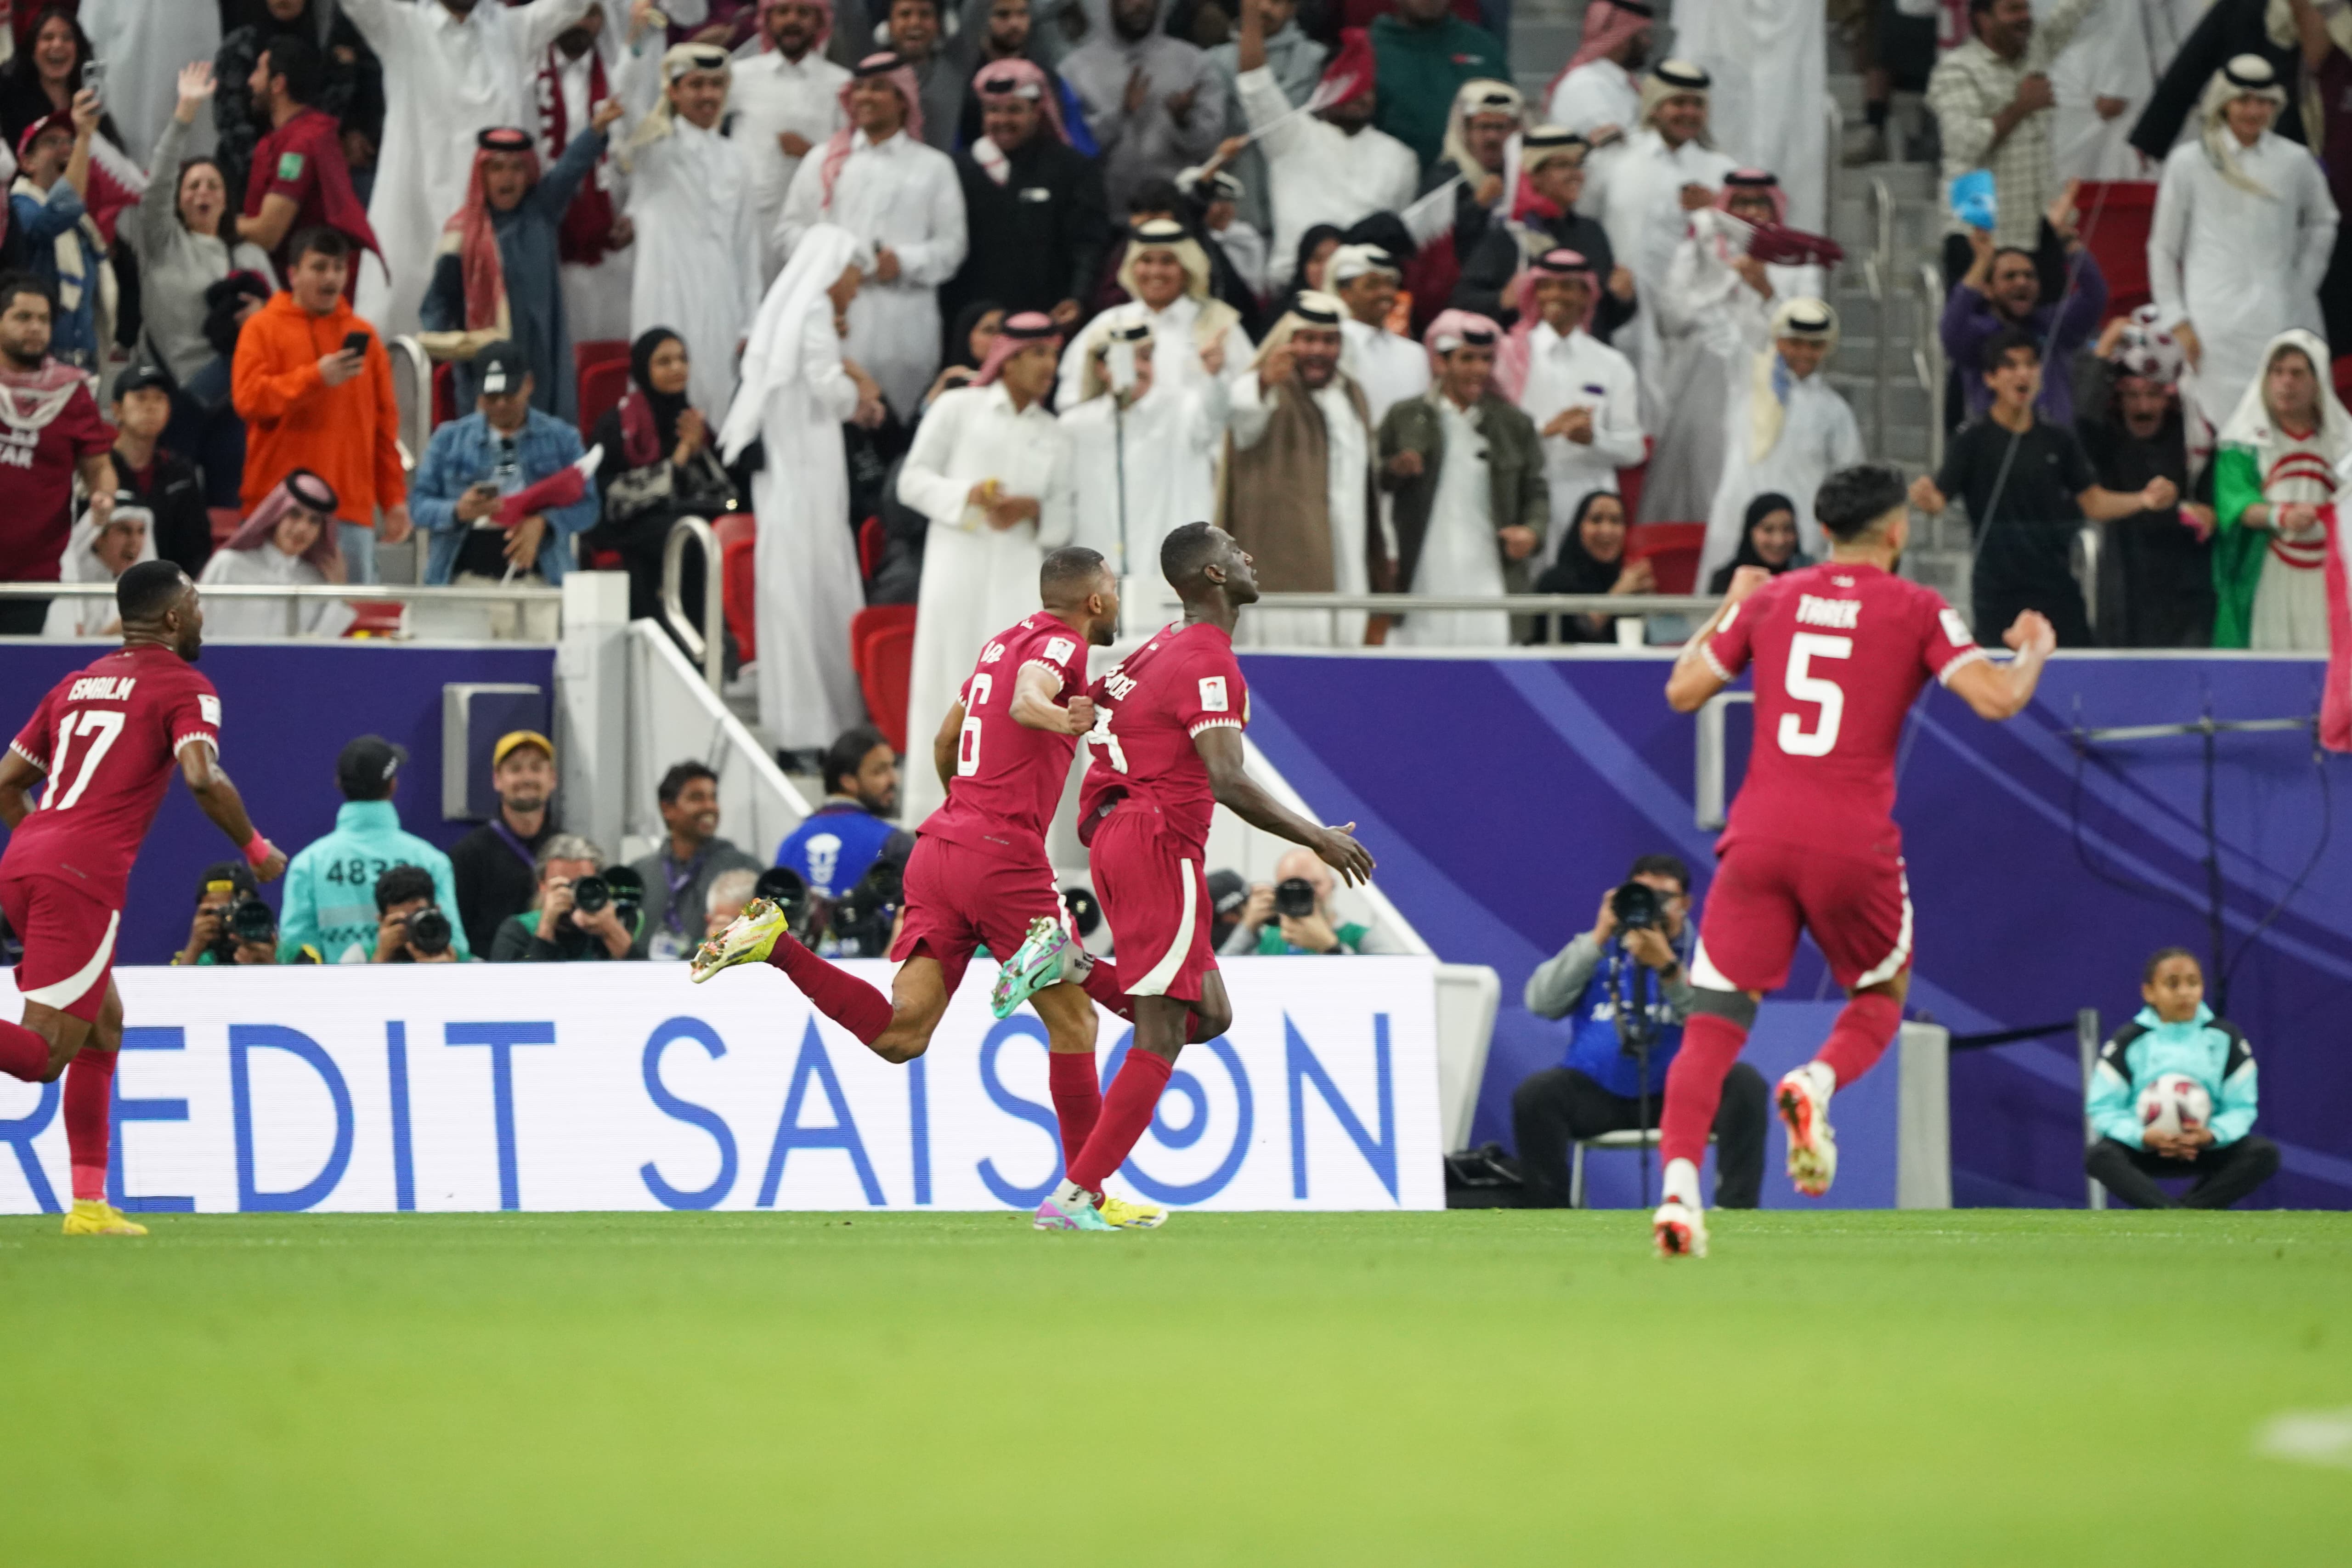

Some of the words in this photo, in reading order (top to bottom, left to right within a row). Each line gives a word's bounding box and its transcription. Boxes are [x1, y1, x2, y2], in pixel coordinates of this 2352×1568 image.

[1795, 593, 1862, 629] TAREK
[957, 673, 992, 777] 6
[1777, 632, 1853, 757] 5
[40, 709, 126, 810] 17
[326, 858, 409, 886] 483
[639, 1011, 1400, 1211] SAISON
